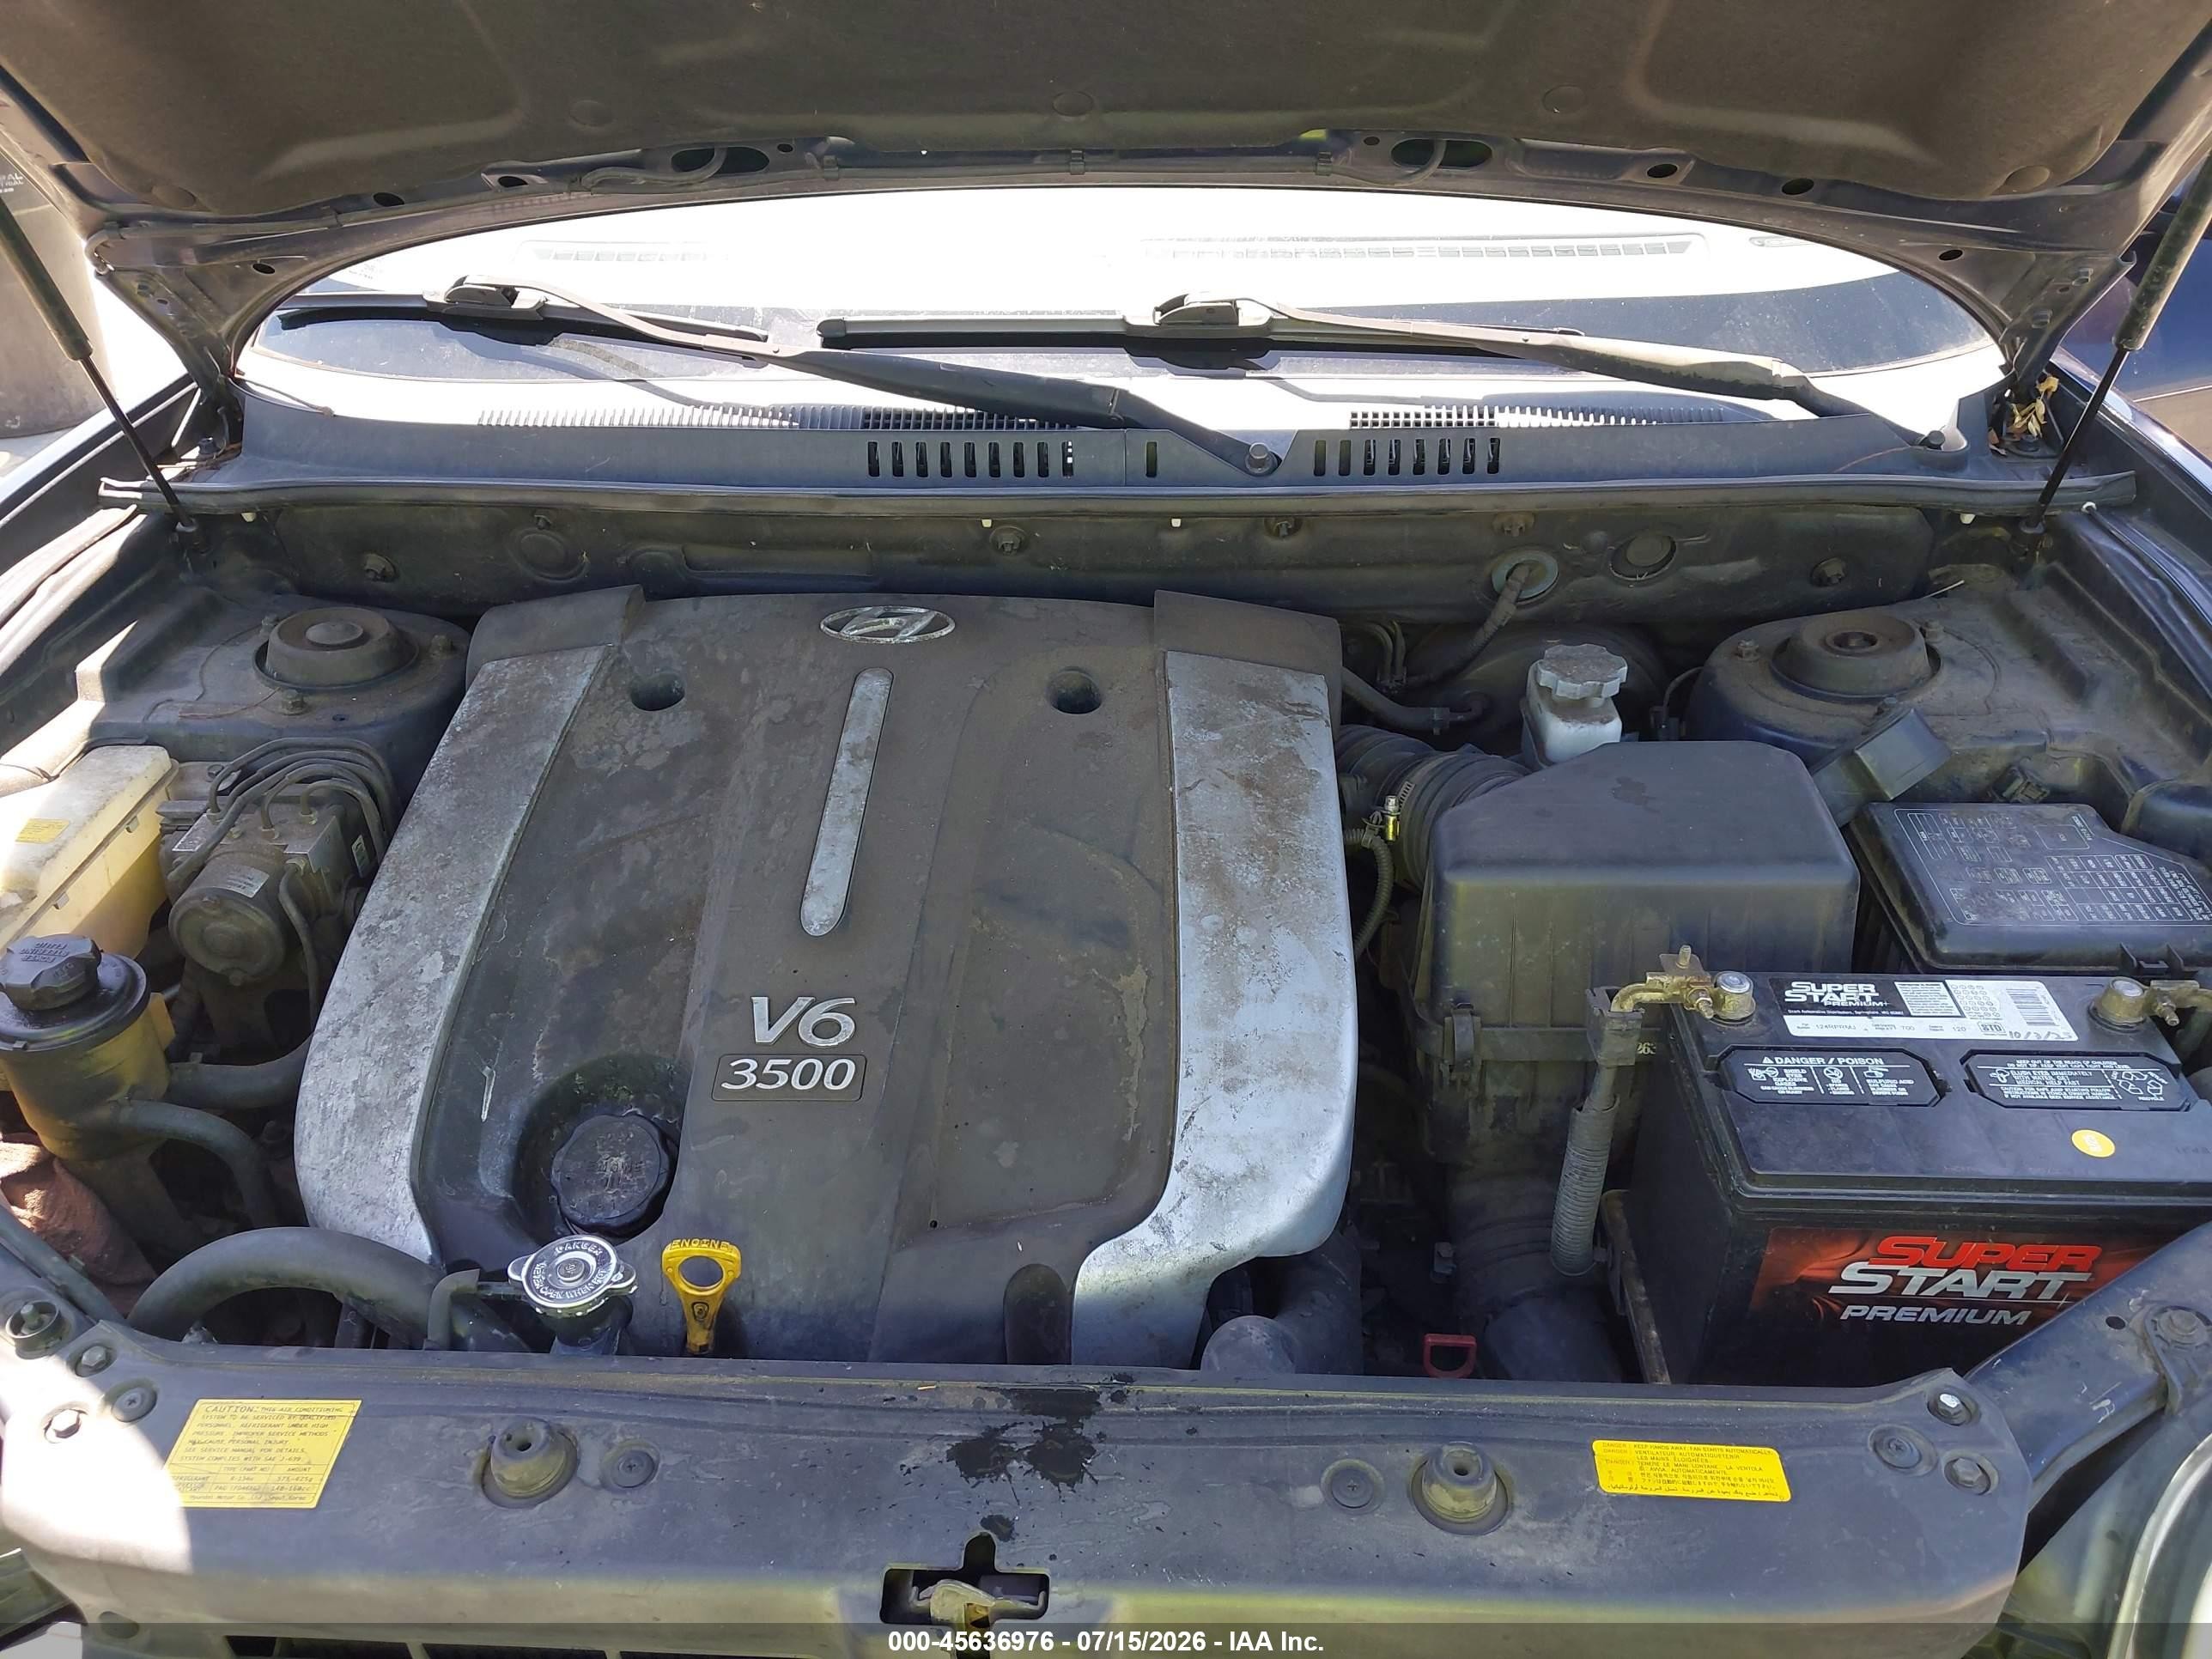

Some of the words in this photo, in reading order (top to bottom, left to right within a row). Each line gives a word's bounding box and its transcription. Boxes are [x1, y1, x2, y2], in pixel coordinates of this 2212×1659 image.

[1784, 990, 1879, 1003] START
[1791, 981, 1876, 993] SUPER
[750, 996, 855, 1047] V6
[721, 1058, 856, 1091] 3500
[672, 1238, 731, 1251] ENGINE
[1869, 1237, 2102, 1271] SUPER
[1828, 1261, 2092, 1300] START
[1840, 1304, 2032, 1326] PREMIUM
